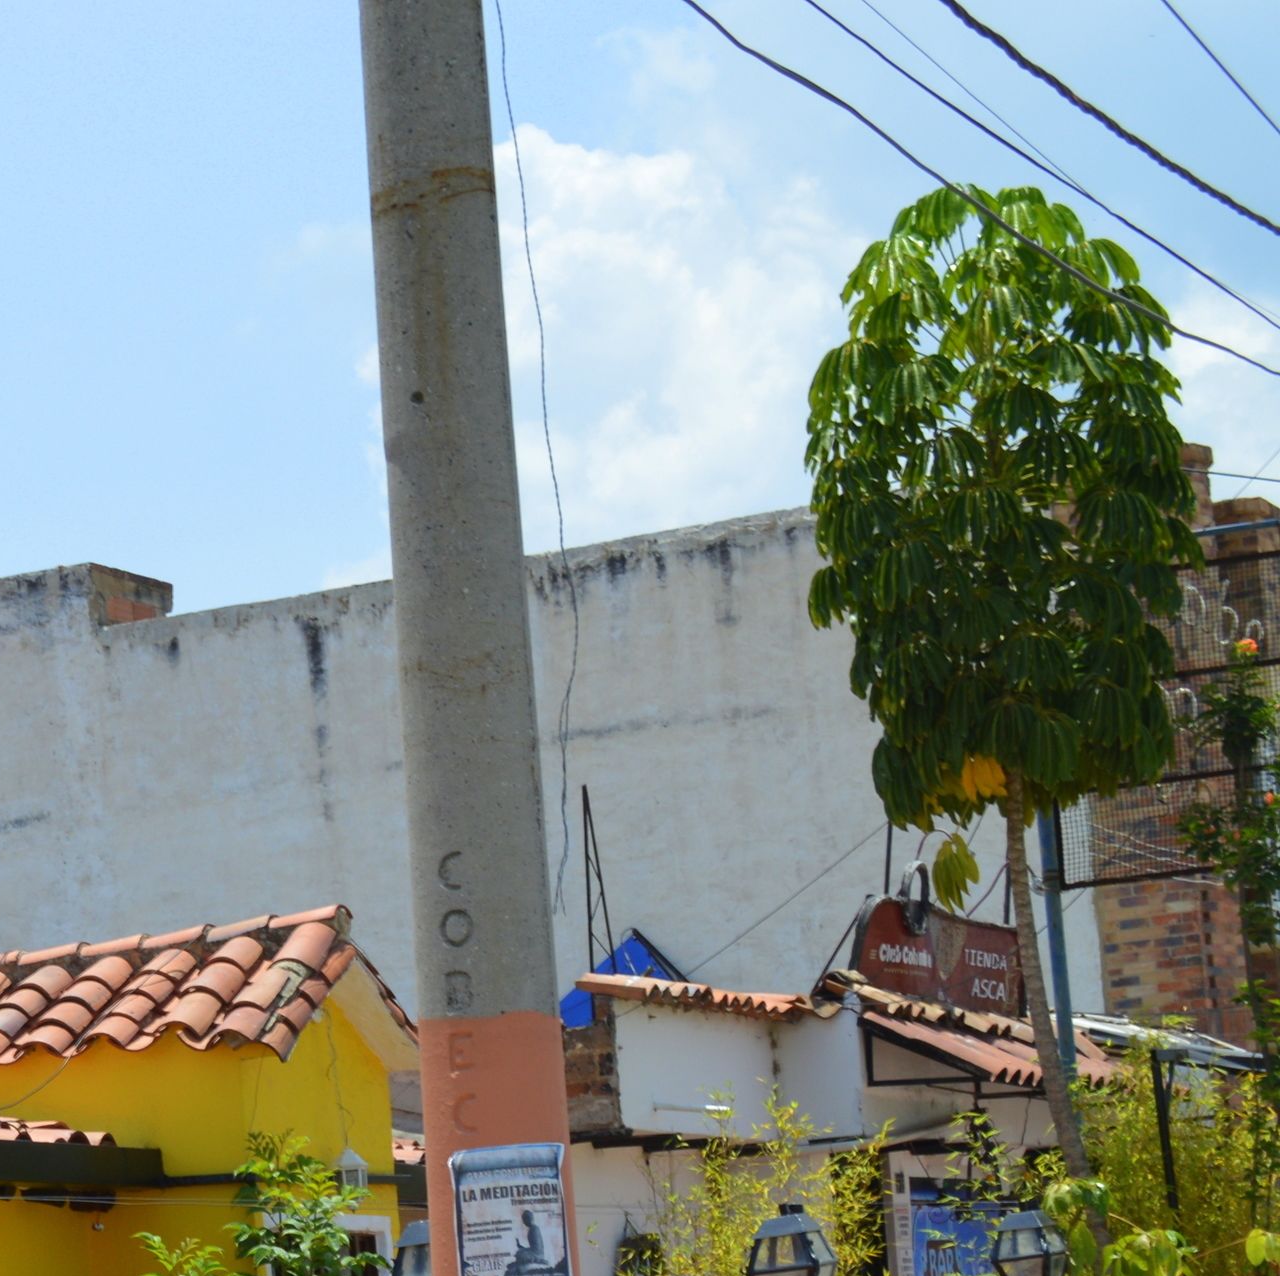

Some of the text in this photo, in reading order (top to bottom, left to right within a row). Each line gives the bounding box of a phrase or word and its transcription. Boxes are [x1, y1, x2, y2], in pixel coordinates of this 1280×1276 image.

[964, 948, 1008, 972] TIENDA
[461, 1180, 559, 1203] LA MEDITACIÓN
